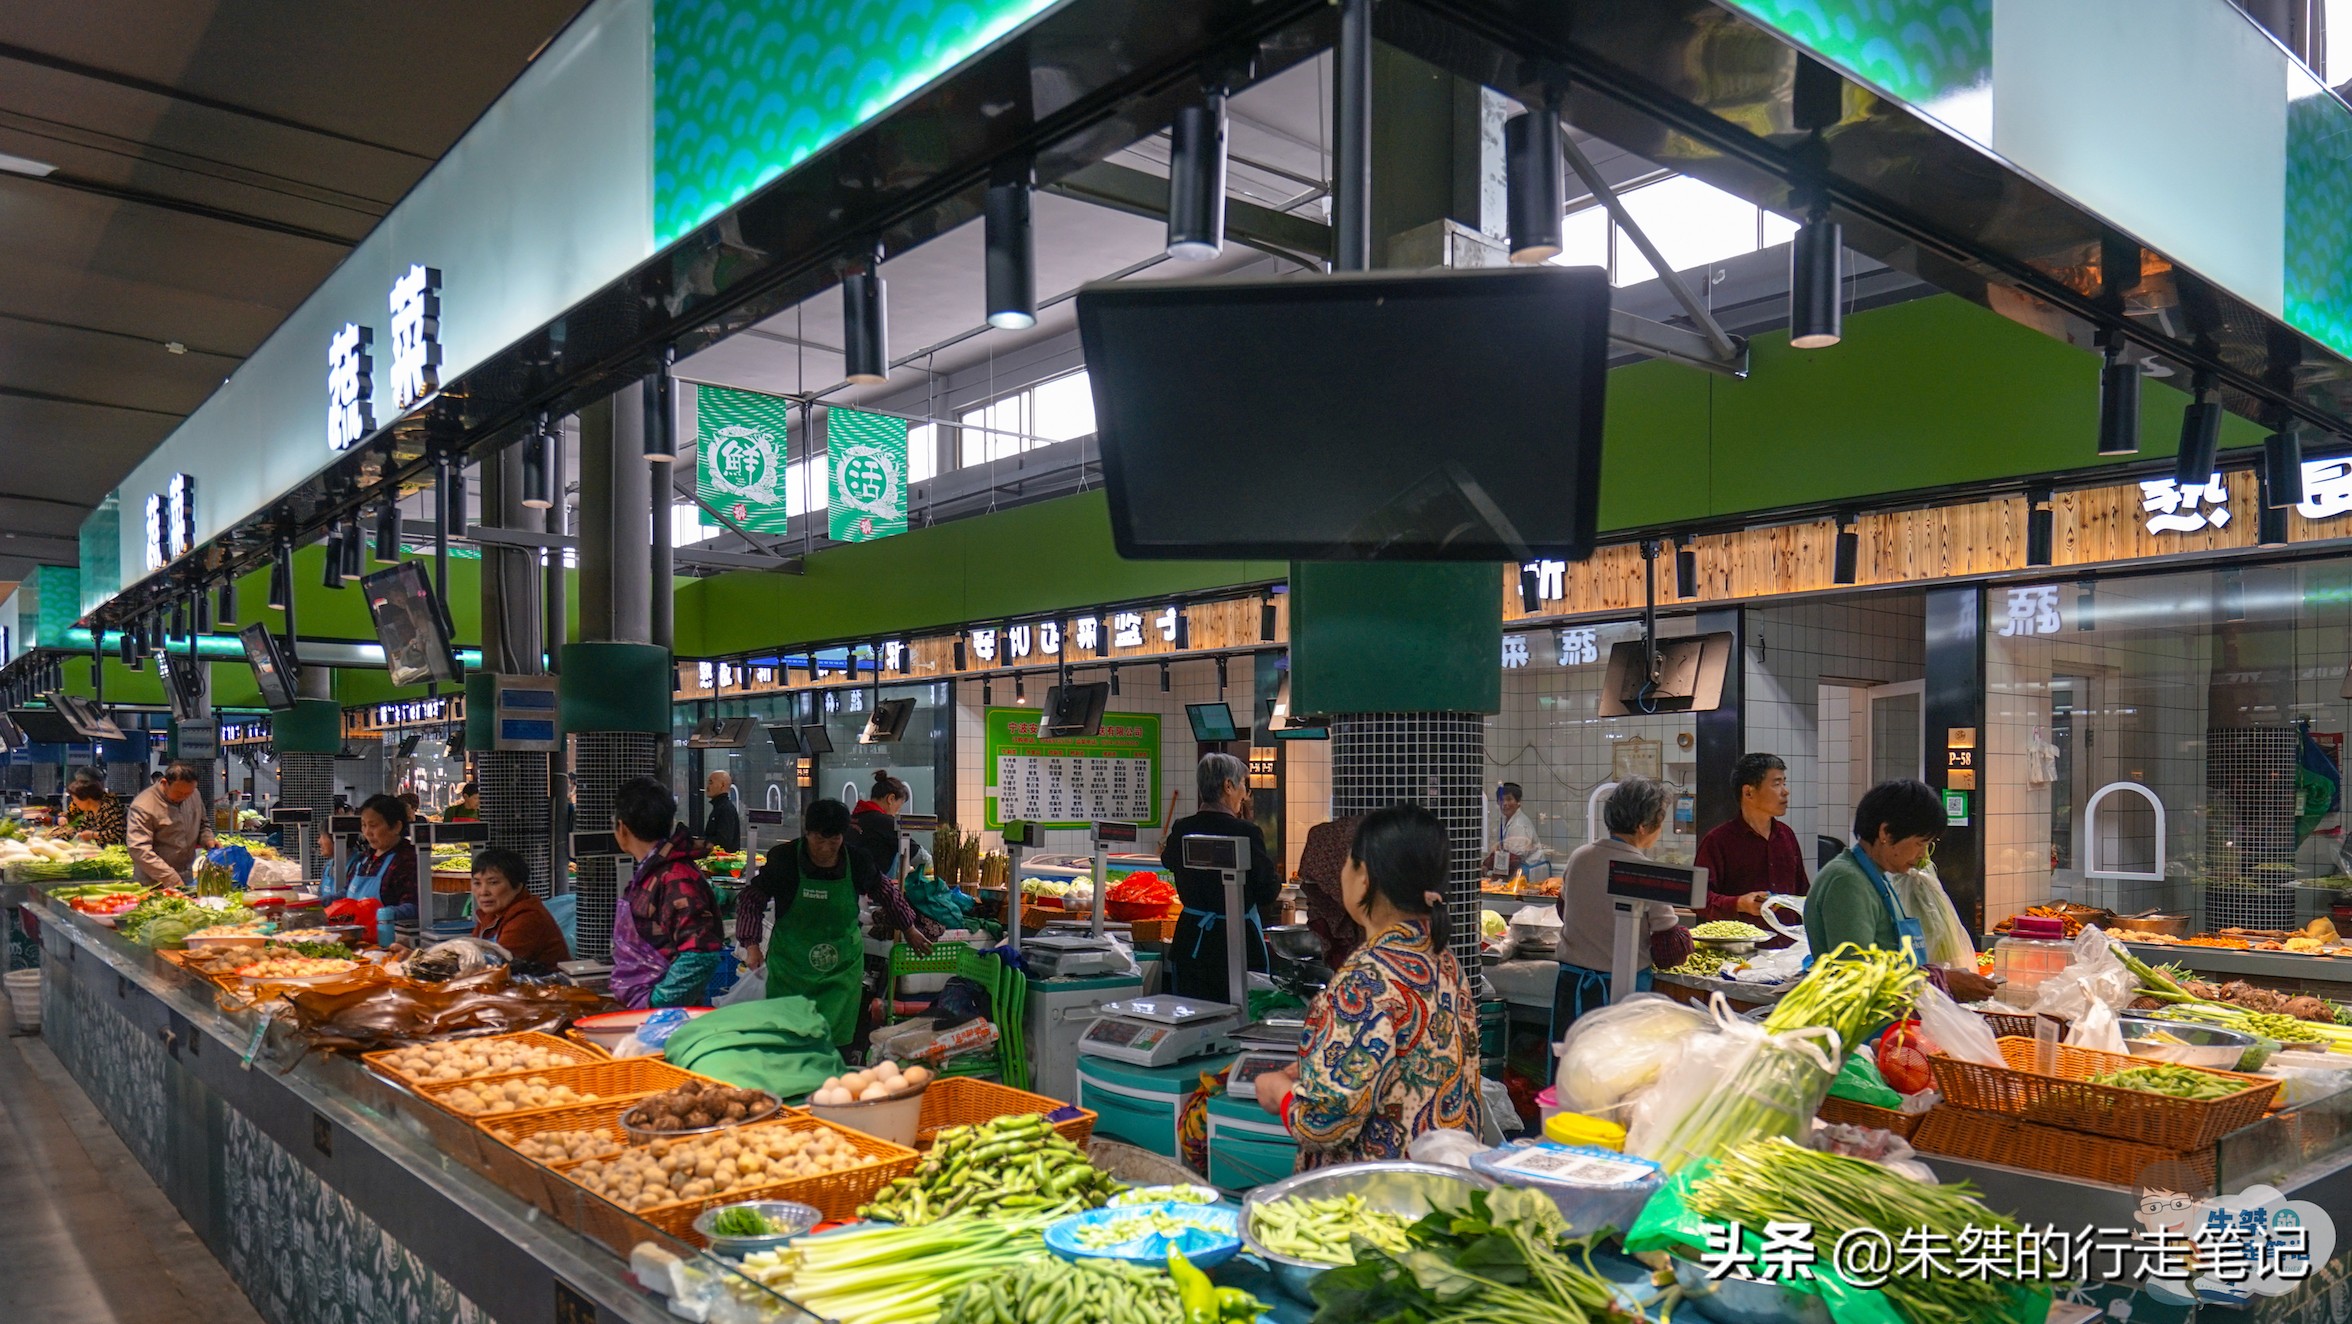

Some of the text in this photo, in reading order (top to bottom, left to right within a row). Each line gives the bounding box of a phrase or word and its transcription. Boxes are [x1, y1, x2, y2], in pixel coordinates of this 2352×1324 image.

[327, 263, 441, 450] 蔬菜
[848, 459, 883, 501] 活
[146, 472, 193, 572] 蔬菜
[1948, 751, 1972, 766] P-58
